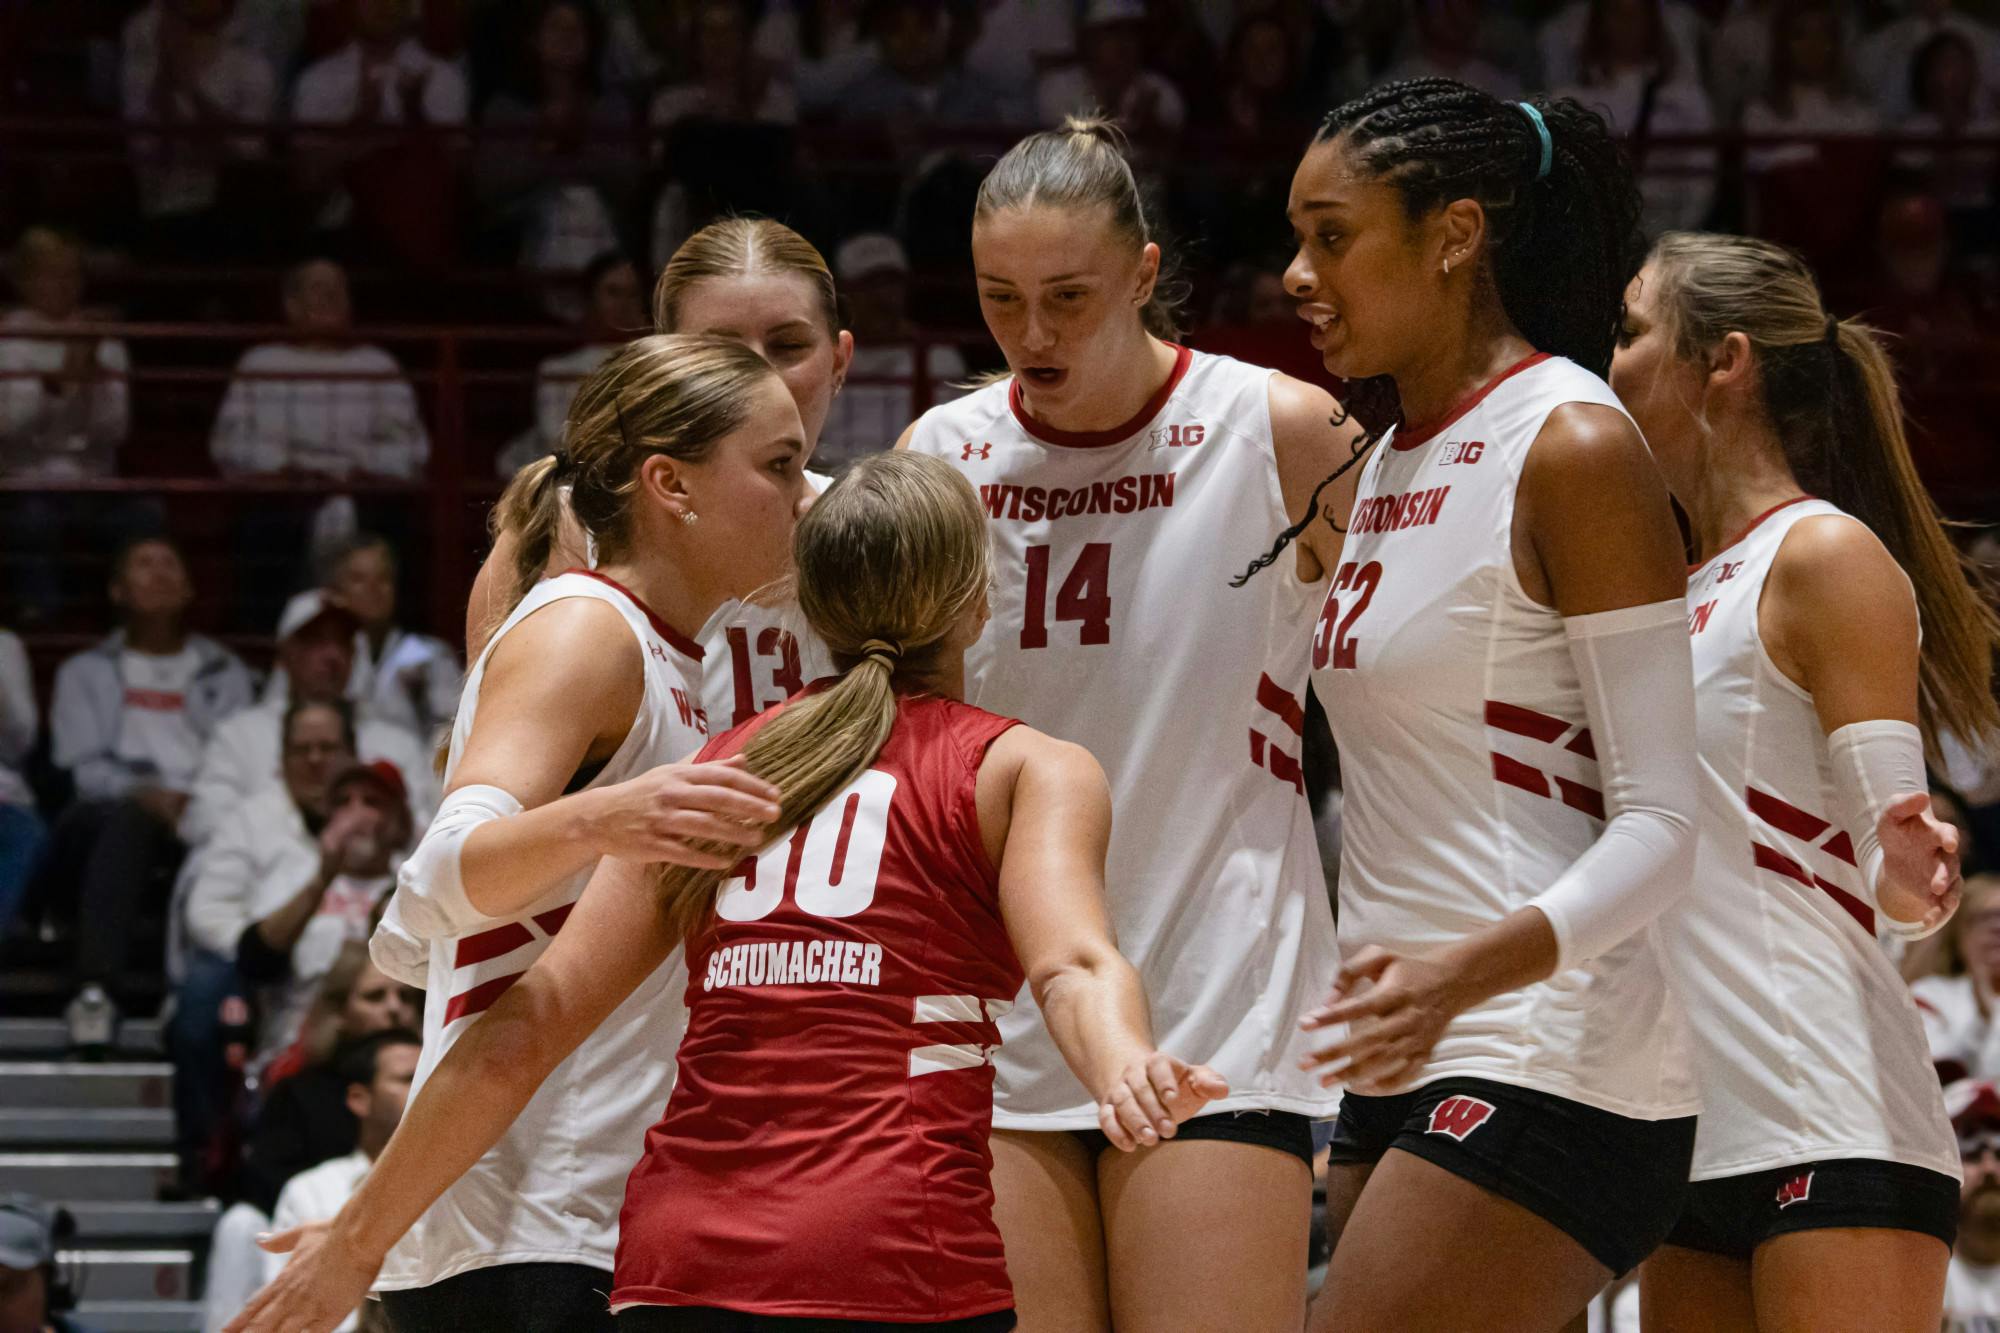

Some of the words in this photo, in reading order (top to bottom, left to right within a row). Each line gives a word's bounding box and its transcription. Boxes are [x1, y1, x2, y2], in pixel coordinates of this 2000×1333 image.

[980, 472, 1176, 522] WISCONSIN
[1020, 543, 1112, 649] 14
[1312, 561, 1383, 670] 52
[725, 626, 804, 728] 13
[703, 940, 883, 992] SCHUMACHER
